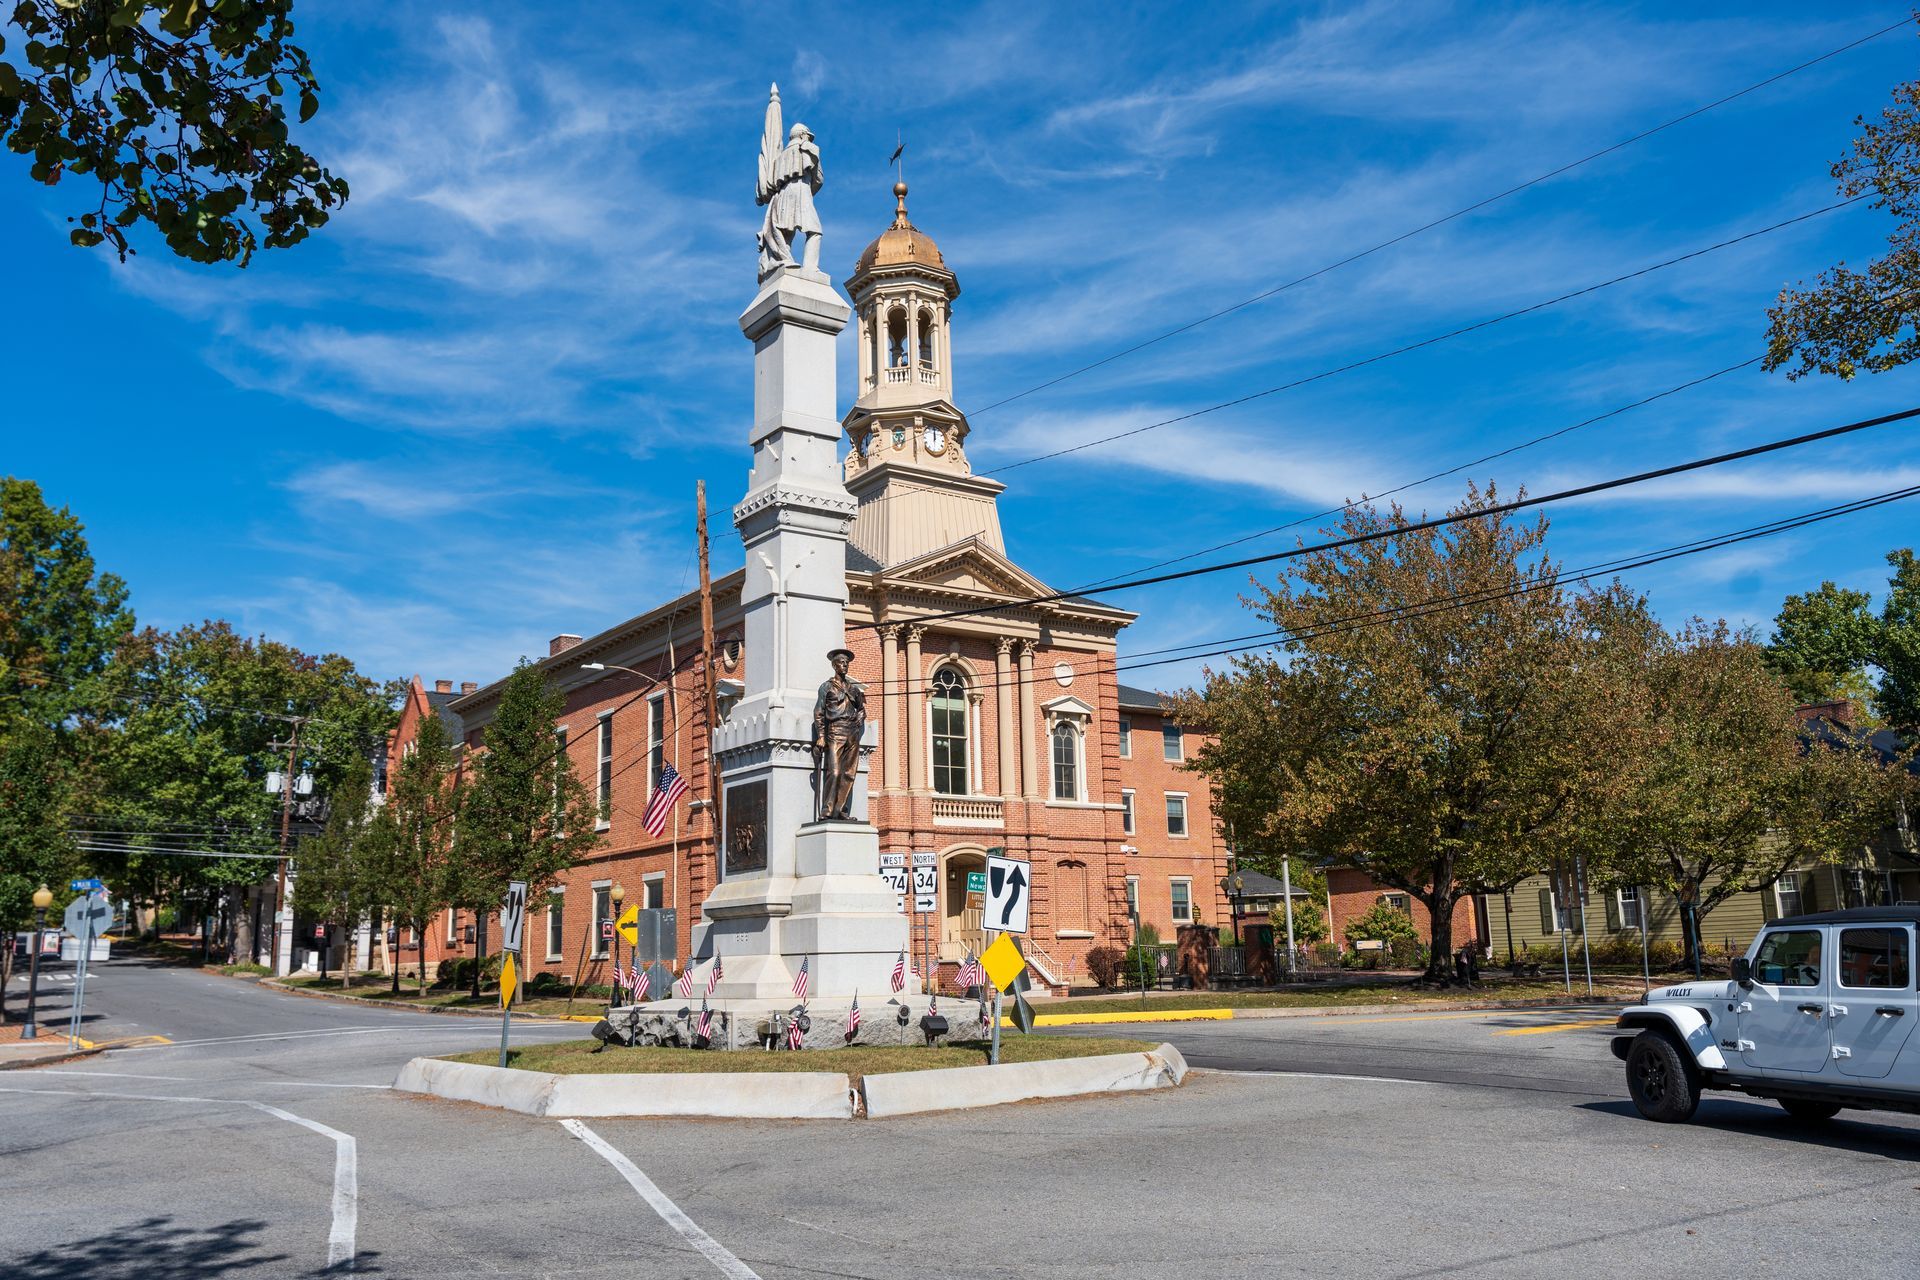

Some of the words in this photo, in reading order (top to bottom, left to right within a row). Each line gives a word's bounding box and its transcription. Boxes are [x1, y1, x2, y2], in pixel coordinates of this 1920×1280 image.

[882, 856, 902, 865] WEST
[913, 855, 935, 864] NORTH
[916, 873, 934, 888] 34
[1666, 988, 1692, 997] WILLYS
[1720, 1039, 1737, 1049] Jeep
